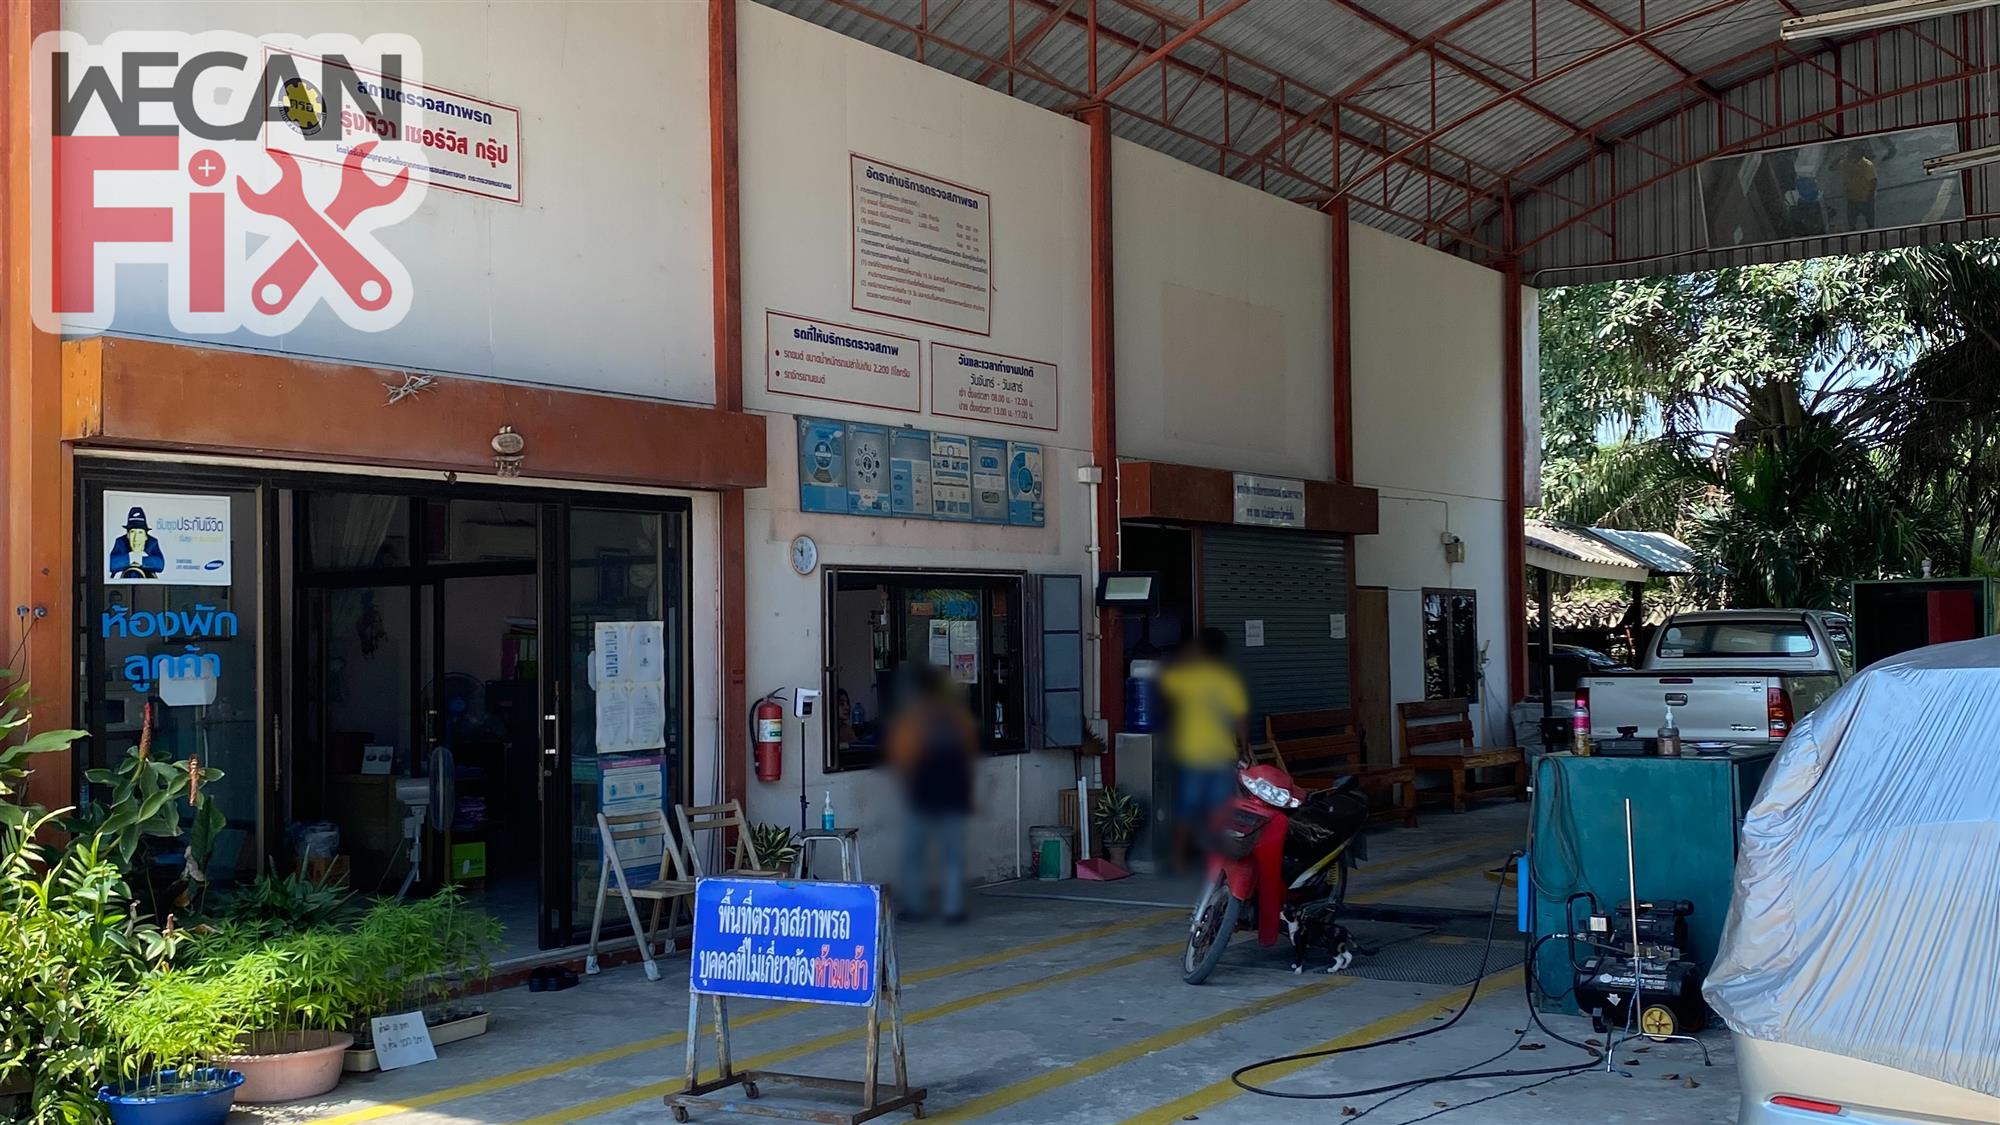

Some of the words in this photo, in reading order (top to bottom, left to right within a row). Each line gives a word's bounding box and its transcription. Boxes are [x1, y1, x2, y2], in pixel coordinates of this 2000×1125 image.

[405, 125, 469, 155] เซอร์วิส
[475, 136, 509, 168] กรุ๊ป
[866, 166, 979, 210] อัตราค่าบริการตรวจสภาพรถ
[793, 325, 899, 356] รถที่ให้บริการตรวจสภาพ
[958, 353, 1034, 378] วันและเวลาทำงานปกติ
[970, 373, 995, 389] วันจันทร์
[1002, 378, 1024, 393] วันเสาร์
[102, 604, 238, 639] ห้องพัก
[123, 644, 222, 693] ลูกค้า
[717, 888, 851, 941] พื้นที่ตรวจสภาพรถ
